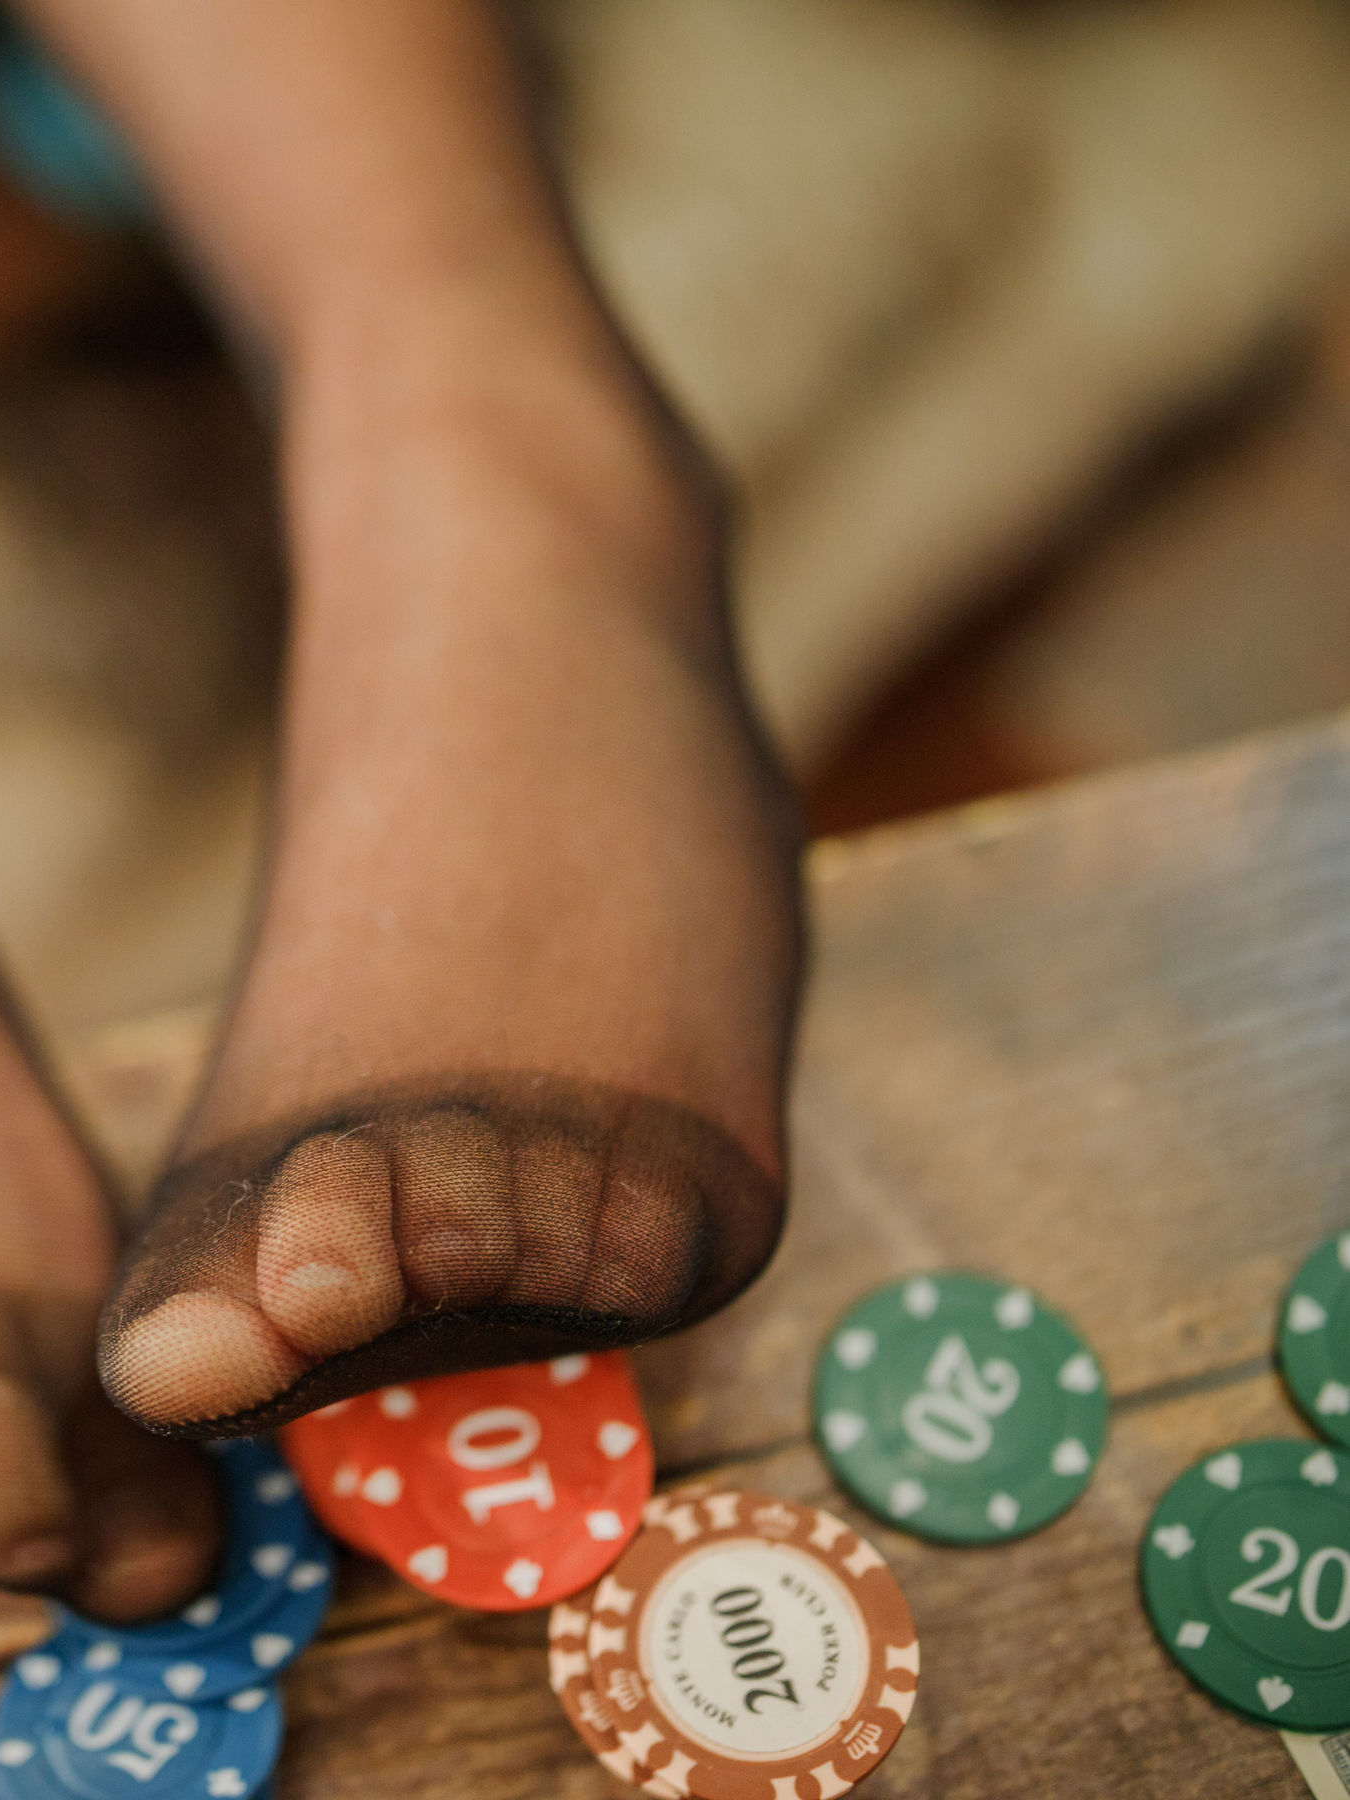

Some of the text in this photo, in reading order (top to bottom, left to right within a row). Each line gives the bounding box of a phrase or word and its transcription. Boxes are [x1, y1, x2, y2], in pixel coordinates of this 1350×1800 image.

[903, 1334, 1020, 1463] 20
[449, 1406, 555, 1526] 10
[1229, 1526, 1350, 1632] 20
[673, 1668, 737, 1728] MONTE
[711, 1587, 800, 1715] 2000
[815, 1622, 840, 1692] POKER
[68, 1681, 199, 1783] 50
